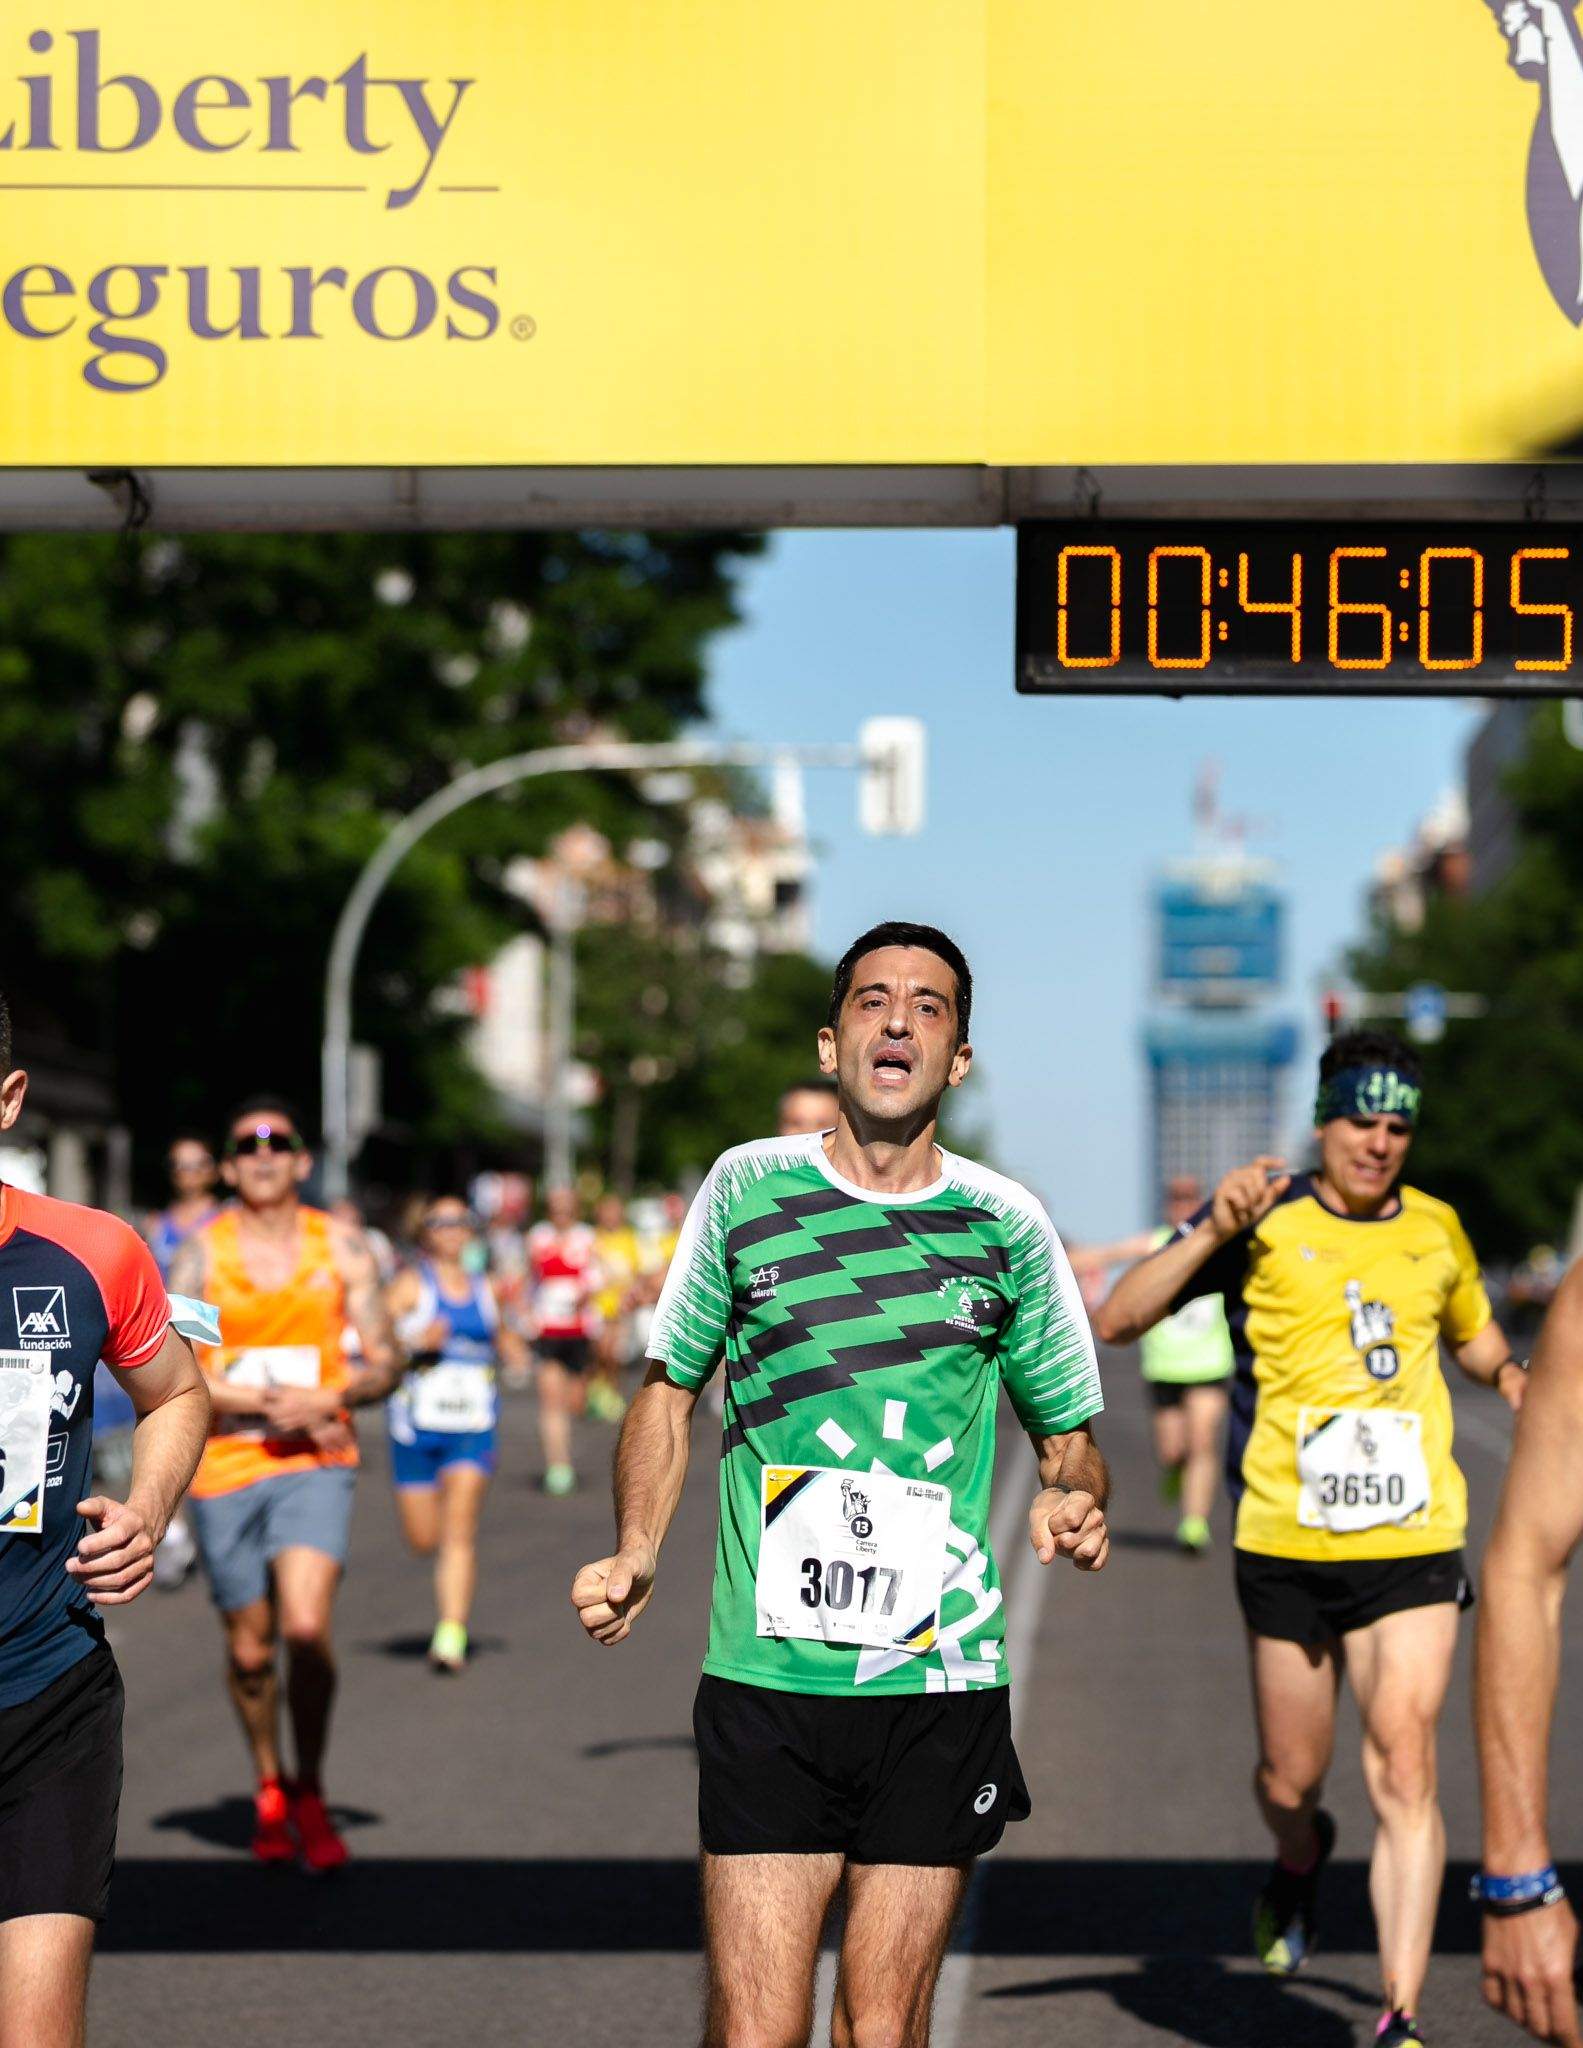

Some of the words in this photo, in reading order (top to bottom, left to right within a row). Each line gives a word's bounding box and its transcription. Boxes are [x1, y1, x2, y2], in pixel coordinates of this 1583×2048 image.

[1058, 546, 1573, 670] 00:46:05
[20, 1312, 60, 1333] AXA
[20, 1338, 72, 1350] fundación
[1321, 1473, 1404, 1505] 3650
[855, 1520, 869, 1534] 13
[801, 1557, 903, 1615] 3017
